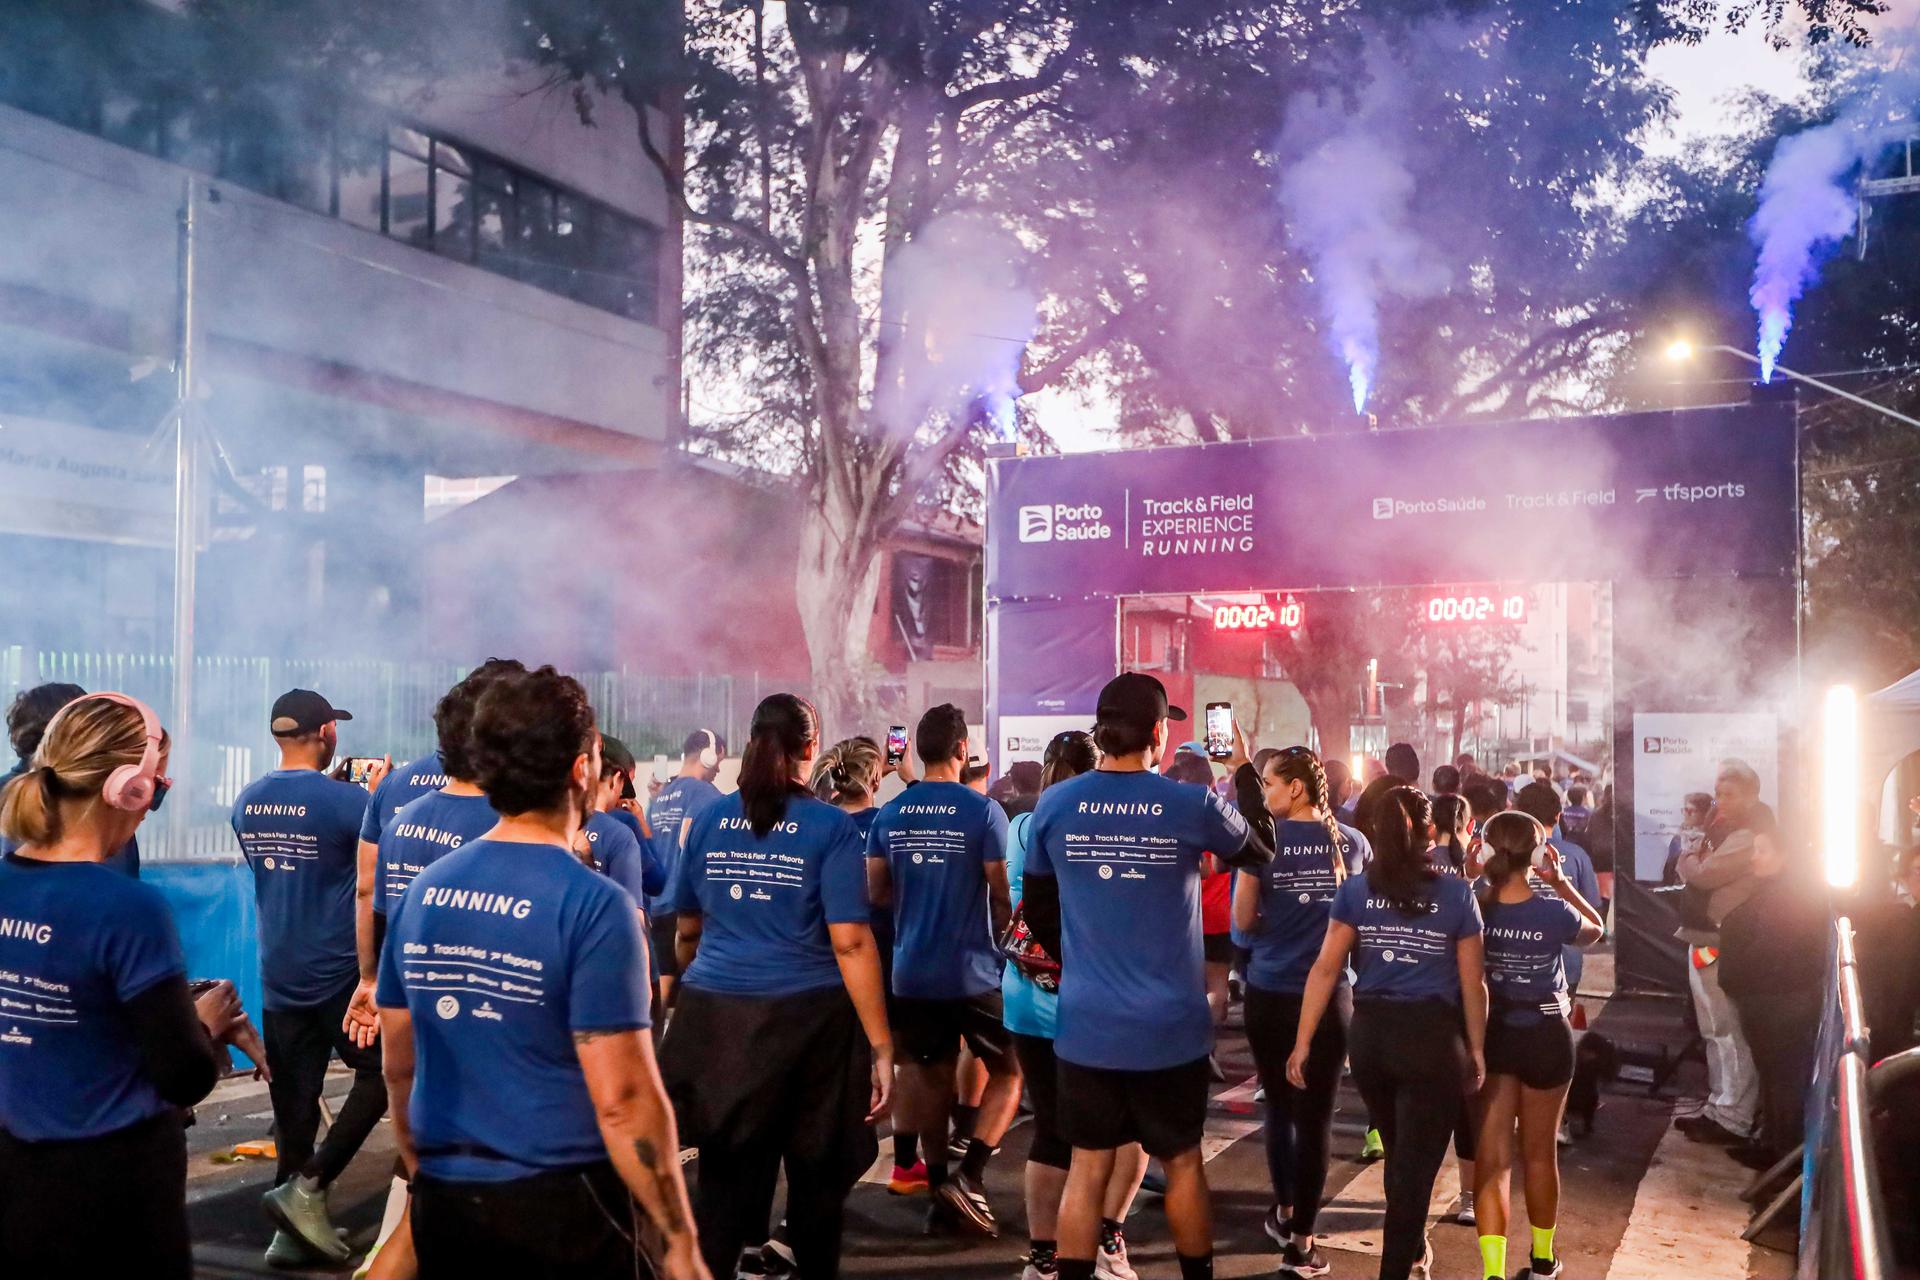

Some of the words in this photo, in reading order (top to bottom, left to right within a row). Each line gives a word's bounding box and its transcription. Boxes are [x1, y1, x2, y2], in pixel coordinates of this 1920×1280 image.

[56, 455, 127, 480] Augusta
[1663, 481, 1745, 502] tfsports
[1054, 503, 1103, 521] Porto
[1055, 521, 1111, 541] Saúde
[1142, 514, 1253, 537] EXPERIENCE
[1143, 536, 1253, 556] RUNNING
[245, 804, 307, 817] RUNNING
[899, 805, 957, 815] RUNNING
[1078, 801, 1163, 816] RUNNING
[719, 817, 799, 834] RUNNG
[395, 823, 463, 849] RUNNING
[1283, 843, 1350, 856] RUNNIG
[422, 886, 532, 919] RUNNING
